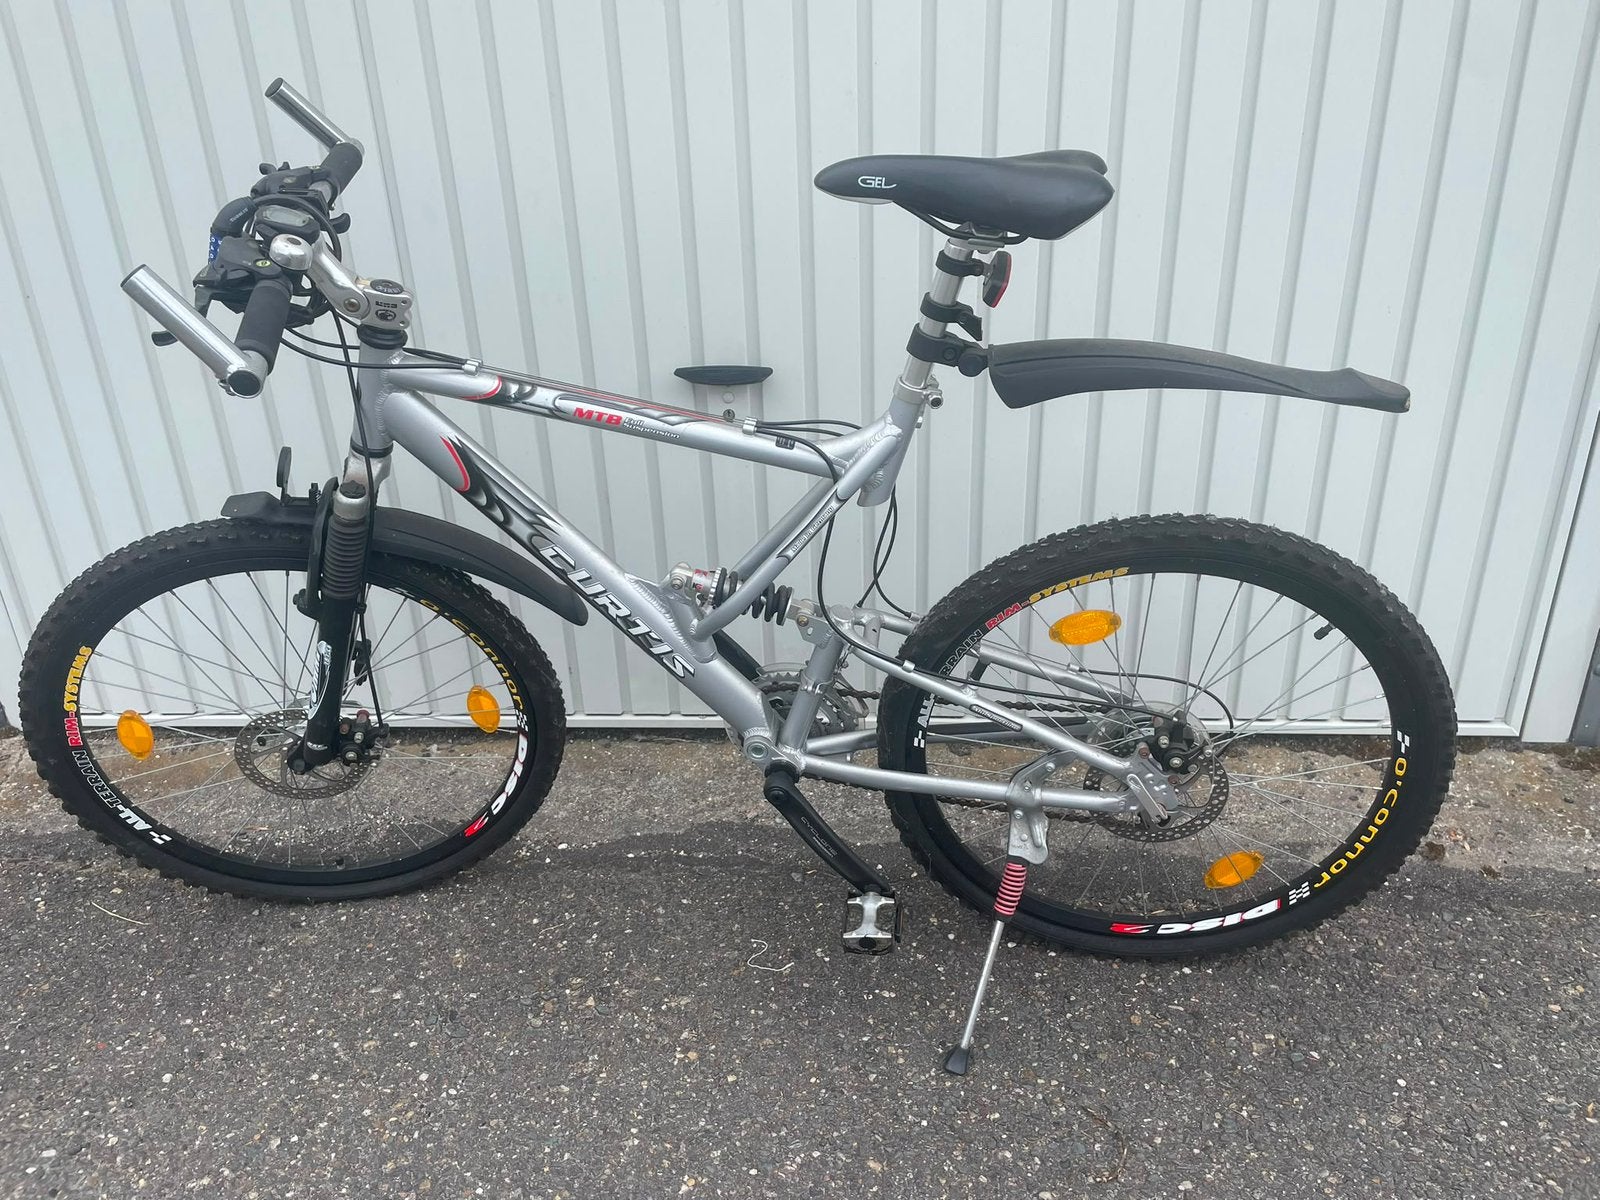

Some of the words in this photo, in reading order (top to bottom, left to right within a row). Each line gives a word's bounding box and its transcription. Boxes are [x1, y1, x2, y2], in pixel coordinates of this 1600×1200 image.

[858, 175, 897, 189] GEL
[573, 407, 623, 426] MTB
[538, 544, 696, 679] CURTIS
[491, 732, 529, 816] DISC
[1156, 898, 1281, 934] DISC
